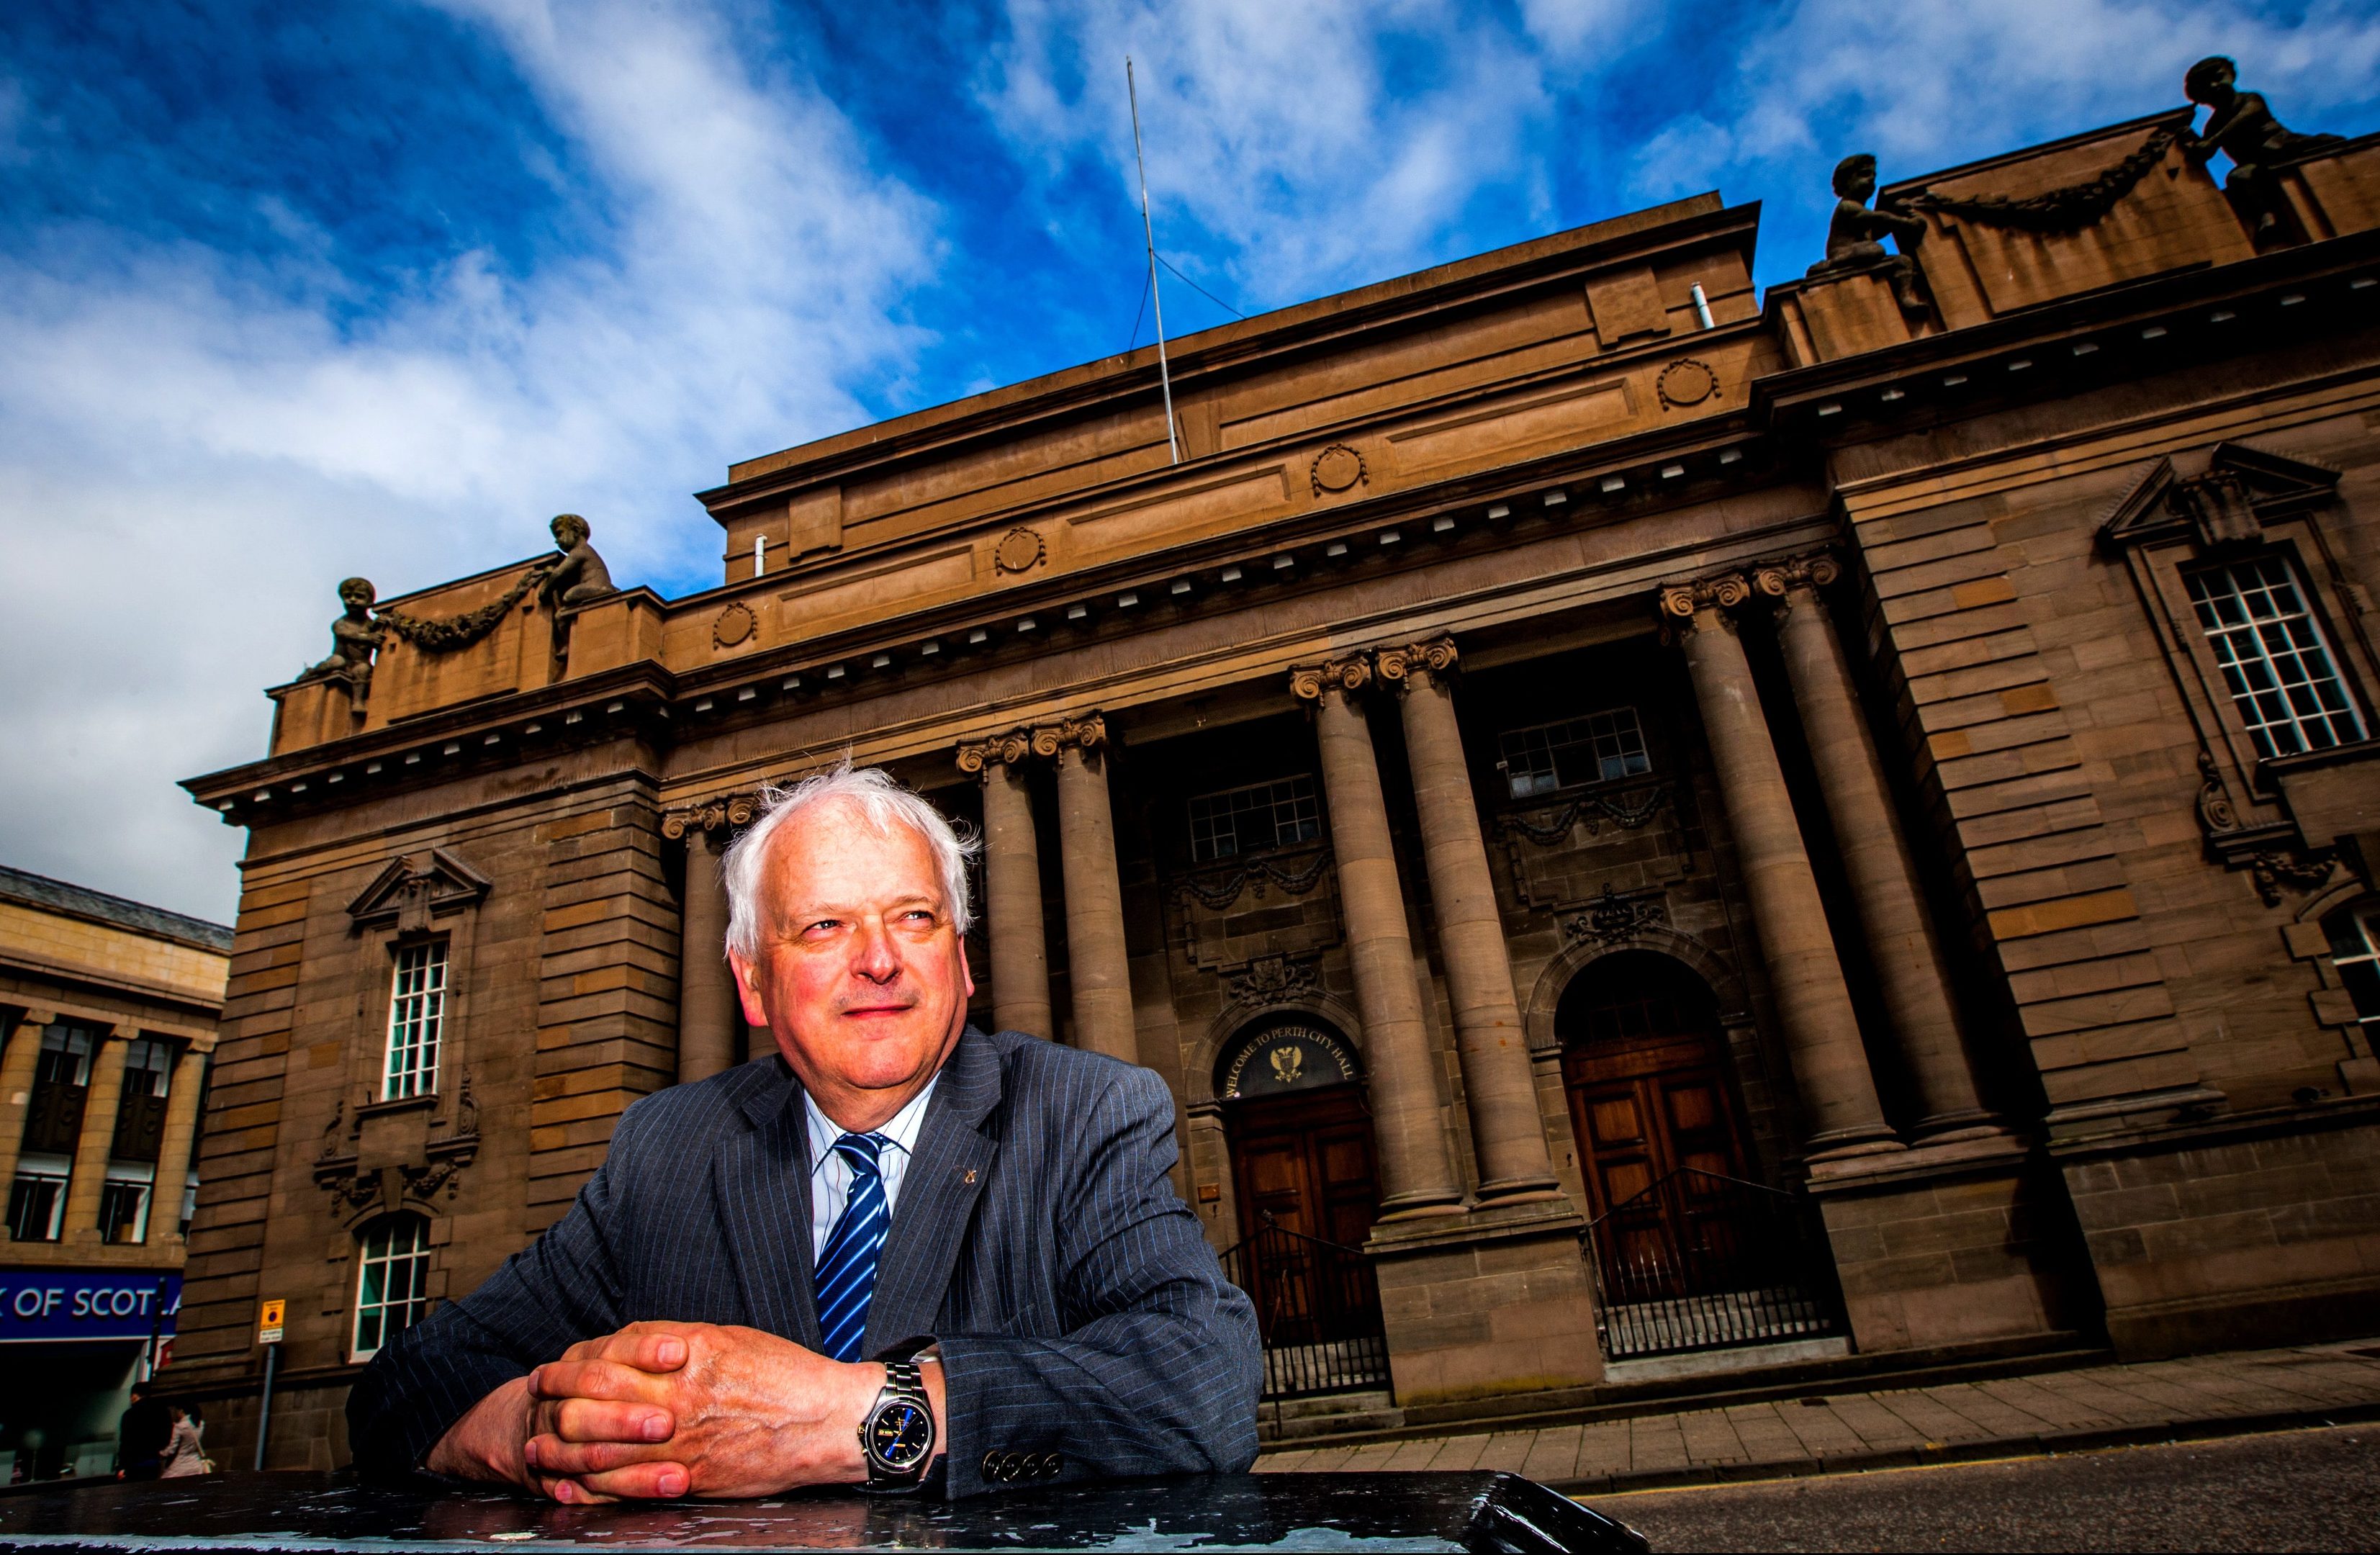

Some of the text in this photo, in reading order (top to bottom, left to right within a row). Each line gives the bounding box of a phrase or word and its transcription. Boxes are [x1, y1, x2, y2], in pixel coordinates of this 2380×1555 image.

[1226, 1027, 1354, 1098] WELCOME TO PERTH CITY HALL
[14, 1287, 65, 1317] OF
